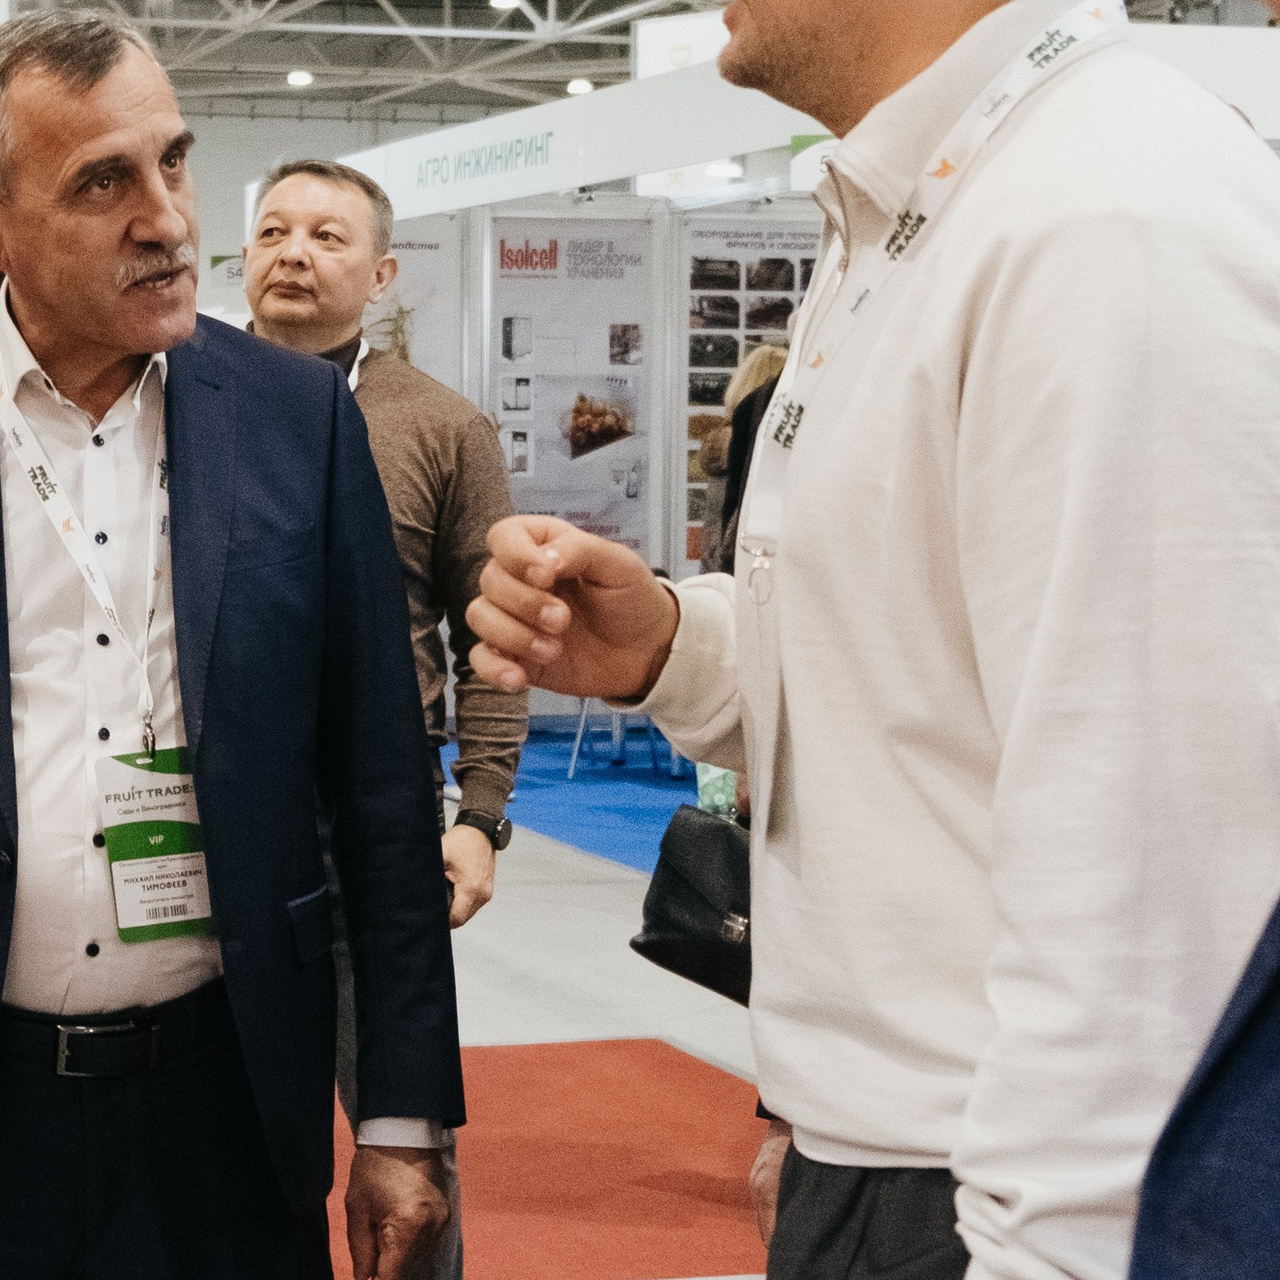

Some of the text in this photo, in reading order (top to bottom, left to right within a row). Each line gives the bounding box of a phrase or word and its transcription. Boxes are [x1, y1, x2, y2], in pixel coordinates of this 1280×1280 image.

[417, 155, 450, 190] АГРО
[148, 835, 165, 845] VIP
[142, 880, 188, 893] ТИМОФЕЕВ
